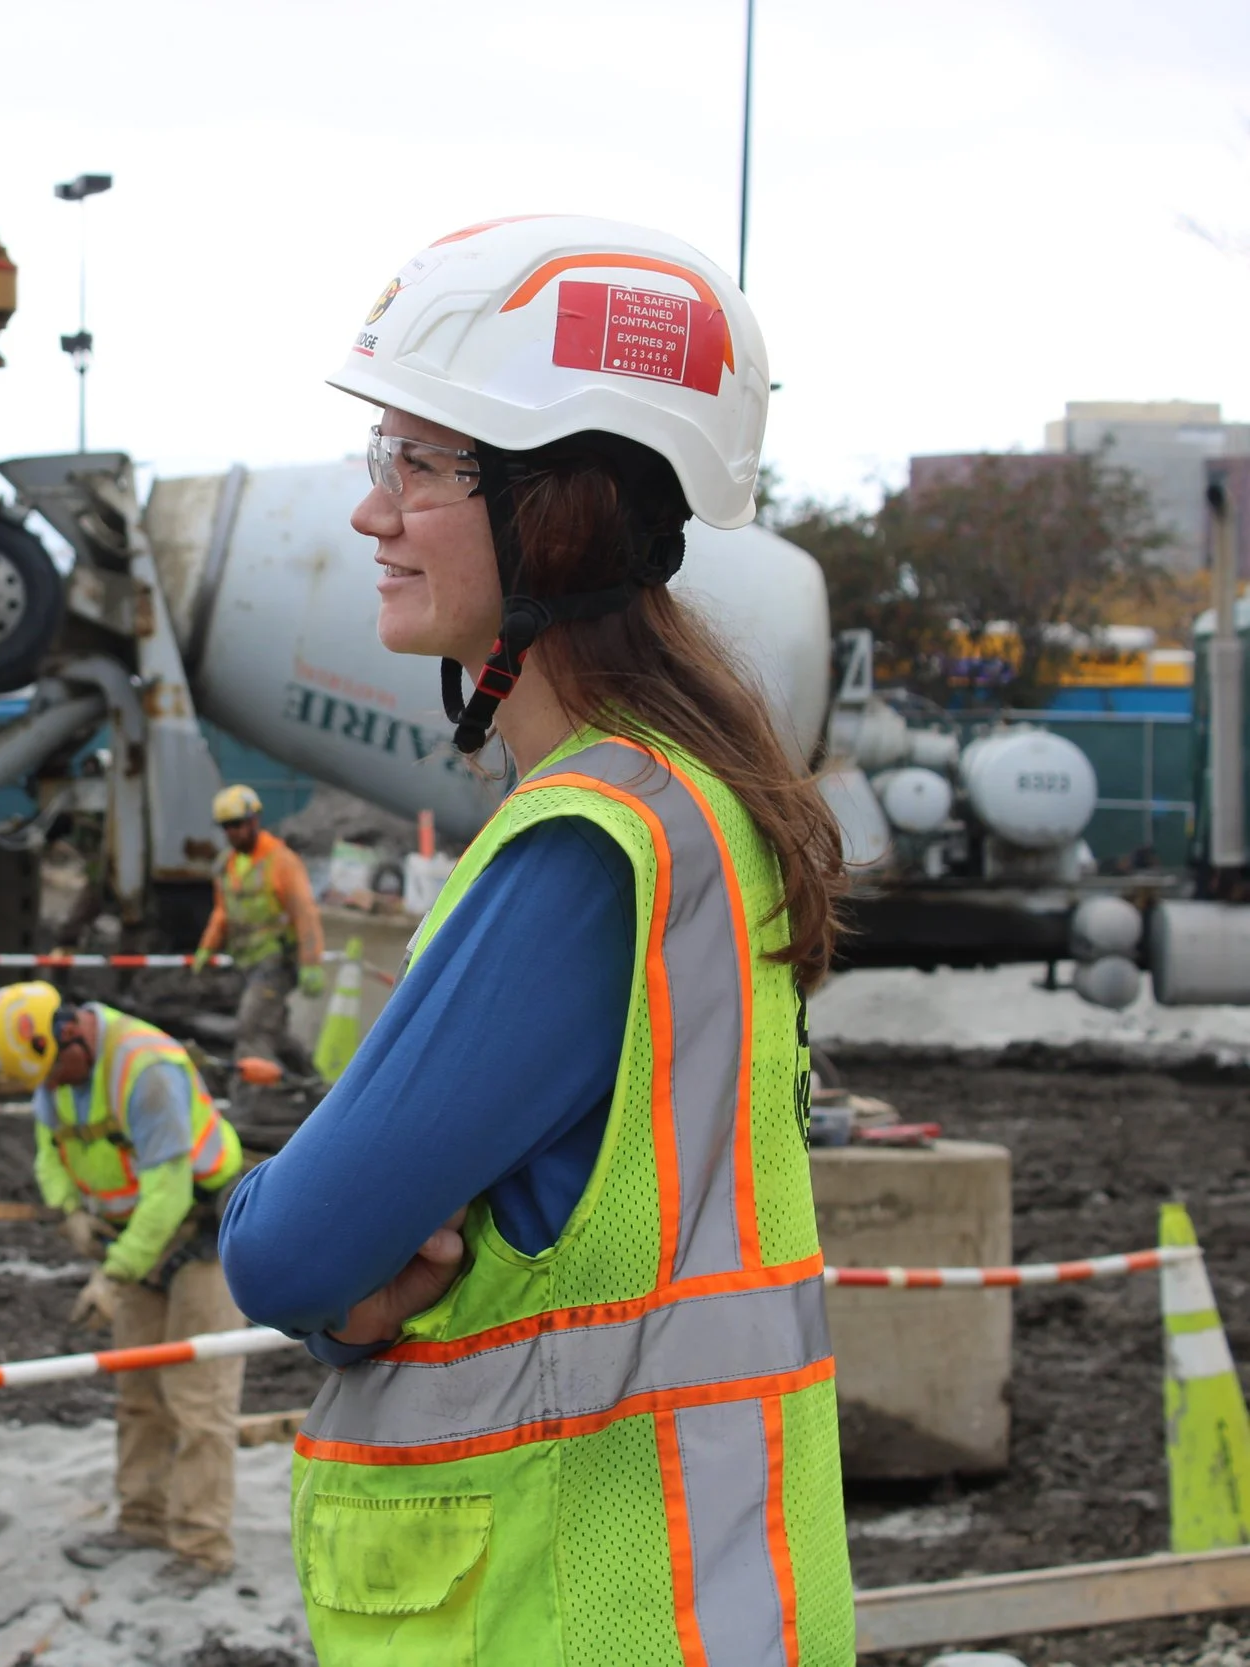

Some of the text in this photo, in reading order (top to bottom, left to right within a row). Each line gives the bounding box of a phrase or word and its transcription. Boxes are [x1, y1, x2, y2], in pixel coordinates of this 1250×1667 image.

[616, 291, 683, 311] RAIL SAFETY
[627, 304, 673, 320] TRAINED
[611, 315, 686, 336] CONTRACTOR
[617, 332, 676, 351] EXPIRES 20
[631, 348, 638, 357] 2
[639, 350, 645, 359] 3
[647, 351, 653, 360] 4
[655, 352, 661, 361] 5
[662, 354, 668, 363] 6
[622, 360, 673, 377] 8 9 10 11 12
[283, 681, 462, 771] AIRIE
